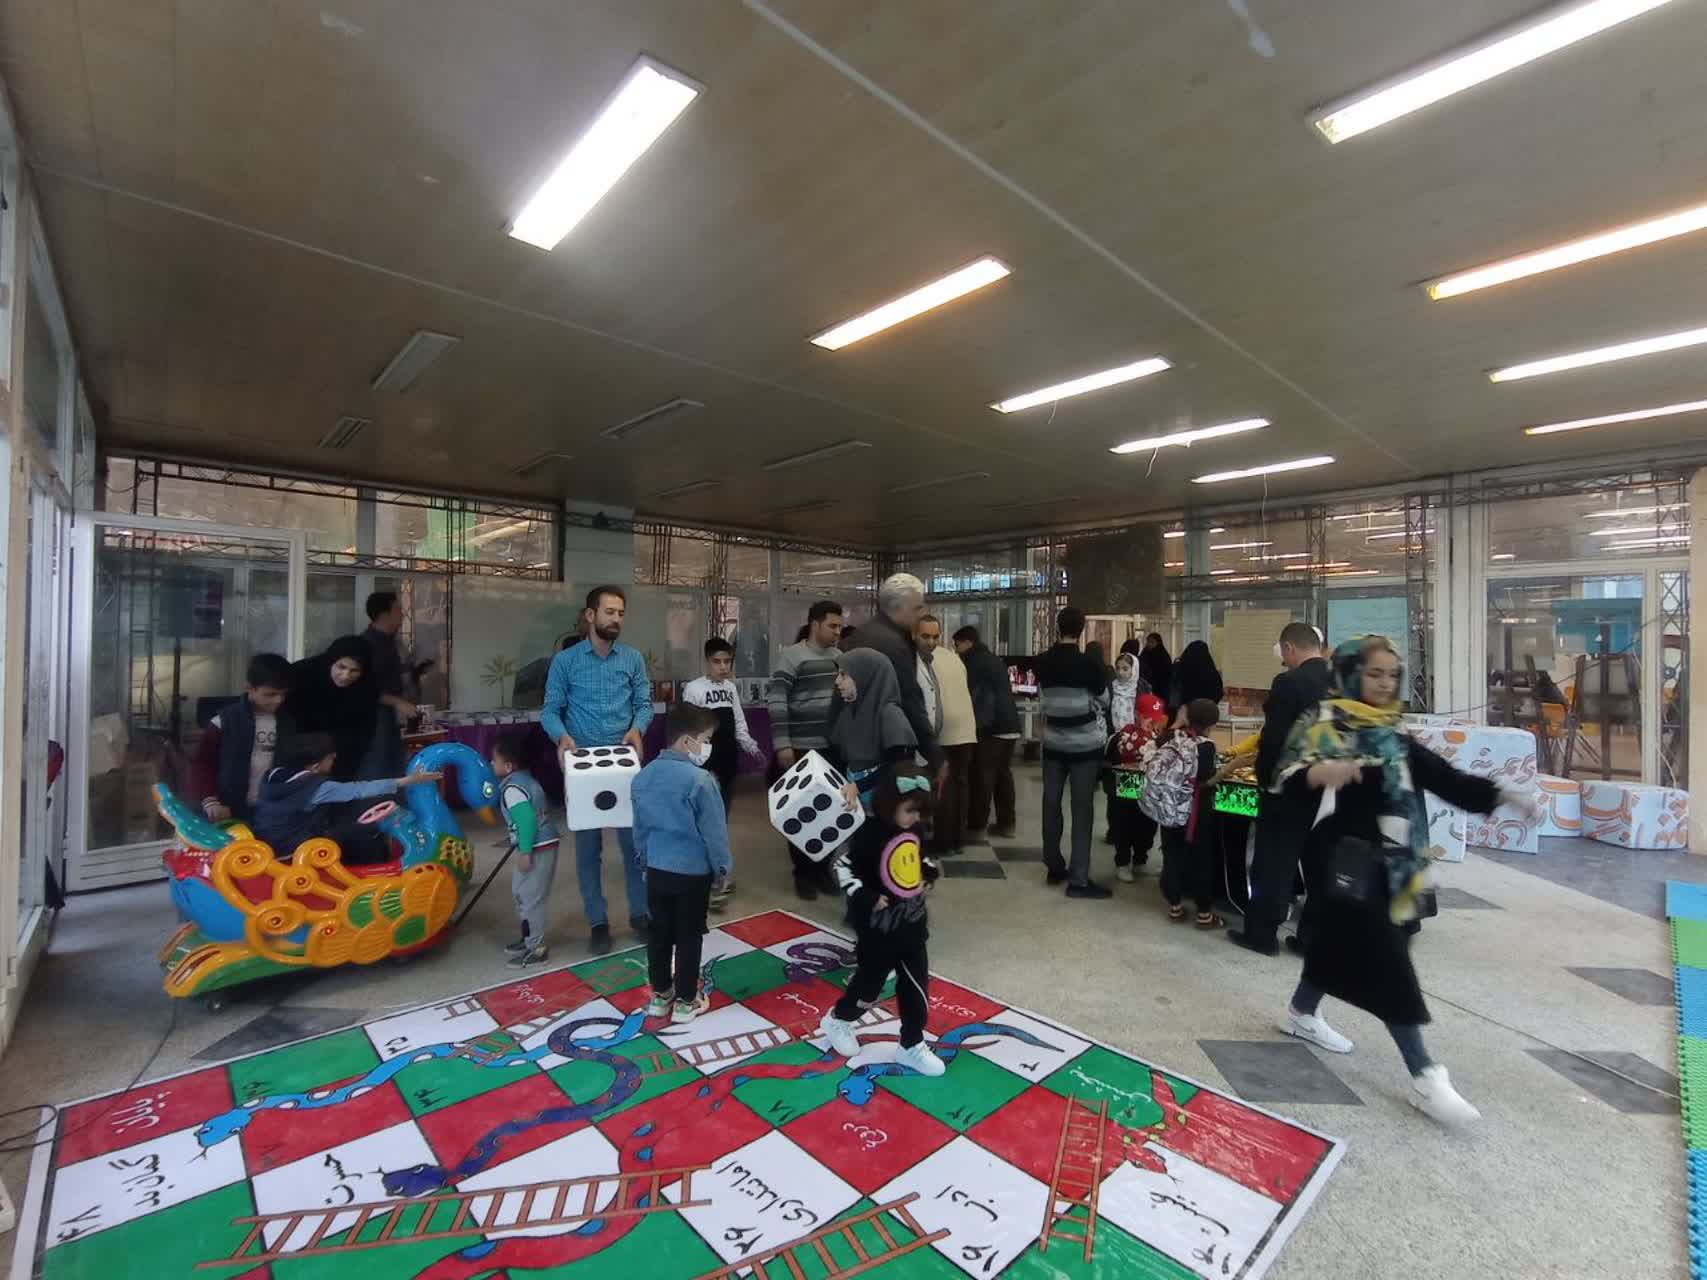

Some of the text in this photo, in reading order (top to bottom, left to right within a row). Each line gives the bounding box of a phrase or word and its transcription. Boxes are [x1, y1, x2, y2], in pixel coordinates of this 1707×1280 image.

[384, 1035, 408, 1055] ۳۵
[413, 1088, 441, 1109] ۳۴
[1069, 1066, 1152, 1105] بخشش
[111, 1090, 171, 1133] پایان
[769, 1100, 797, 1120] ۱۸
[842, 1122, 887, 1151] دروغ
[108, 1153, 175, 1207] گمان بد
[323, 1152, 363, 1207] حسرت
[715, 1161, 818, 1225] امانتداری
[935, 1185, 998, 1222] ادب
[1150, 1191, 1230, 1236] غیبت
[56, 1205, 101, 1243] ۴۸
[724, 1226, 762, 1256] ۲۶
[961, 1244, 999, 1272] ۱۶
[1197, 1243, 1232, 1276] ۱۴
